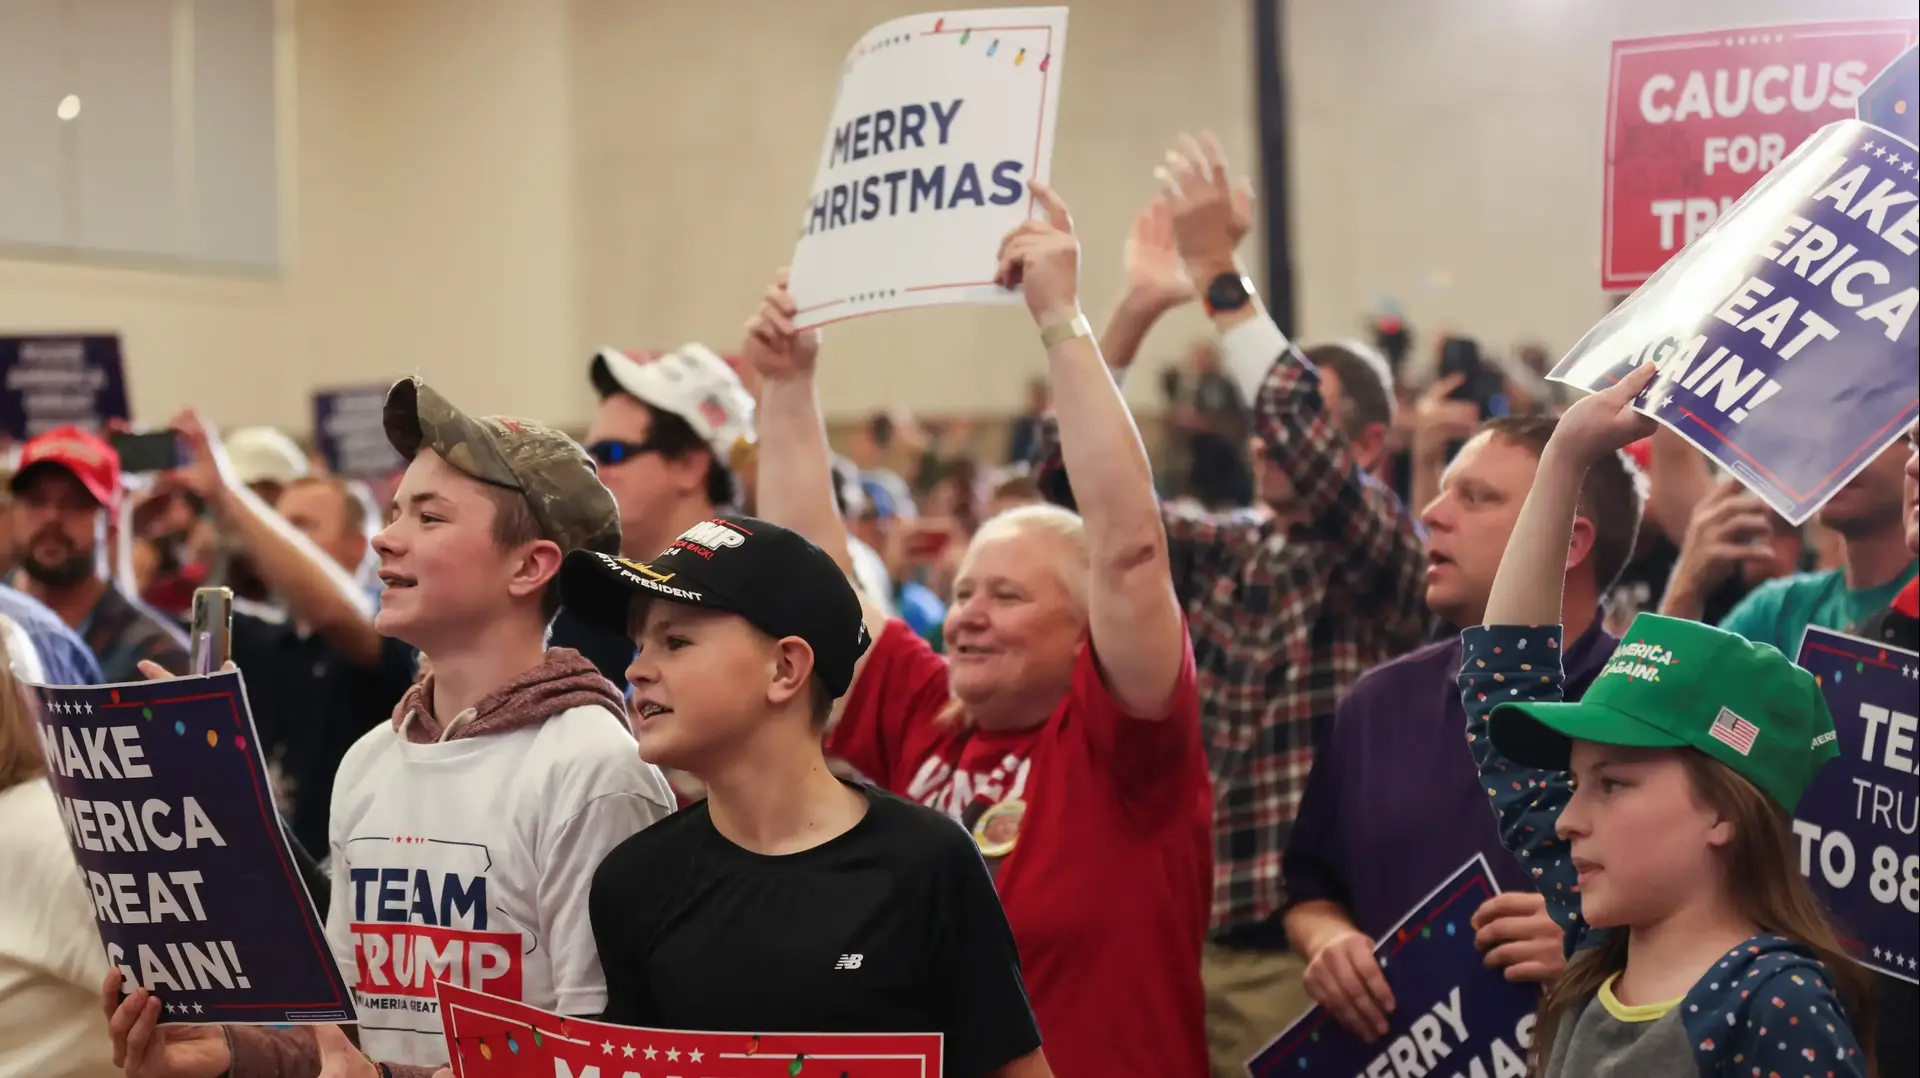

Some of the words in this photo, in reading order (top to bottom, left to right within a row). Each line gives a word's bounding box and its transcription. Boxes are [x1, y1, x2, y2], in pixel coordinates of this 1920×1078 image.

[1638, 60, 1868, 124] CAUCUS
[829, 98, 964, 169] MERRY
[1704, 133, 1786, 175] FOR
[803, 160, 1024, 235] HRISTMAS
[1812, 158, 1919, 256] AKE
[1758, 213, 1919, 342] ERICA
[1715, 275, 1840, 361] EAT
[620, 569, 702, 601] PRESIDENT
[1613, 643, 1672, 666] MERICA
[37, 724, 153, 780] MAKE
[1859, 701, 1919, 775] TE
[60, 796, 227, 853] MERICA
[1793, 819, 1856, 889] TO
[79, 870, 207, 924] REAT
[350, 867, 488, 931] TEAM
[107, 940, 252, 993] GAIN!
[352, 931, 511, 992] TRUMP
[1354, 985, 1470, 1078] ERRY
